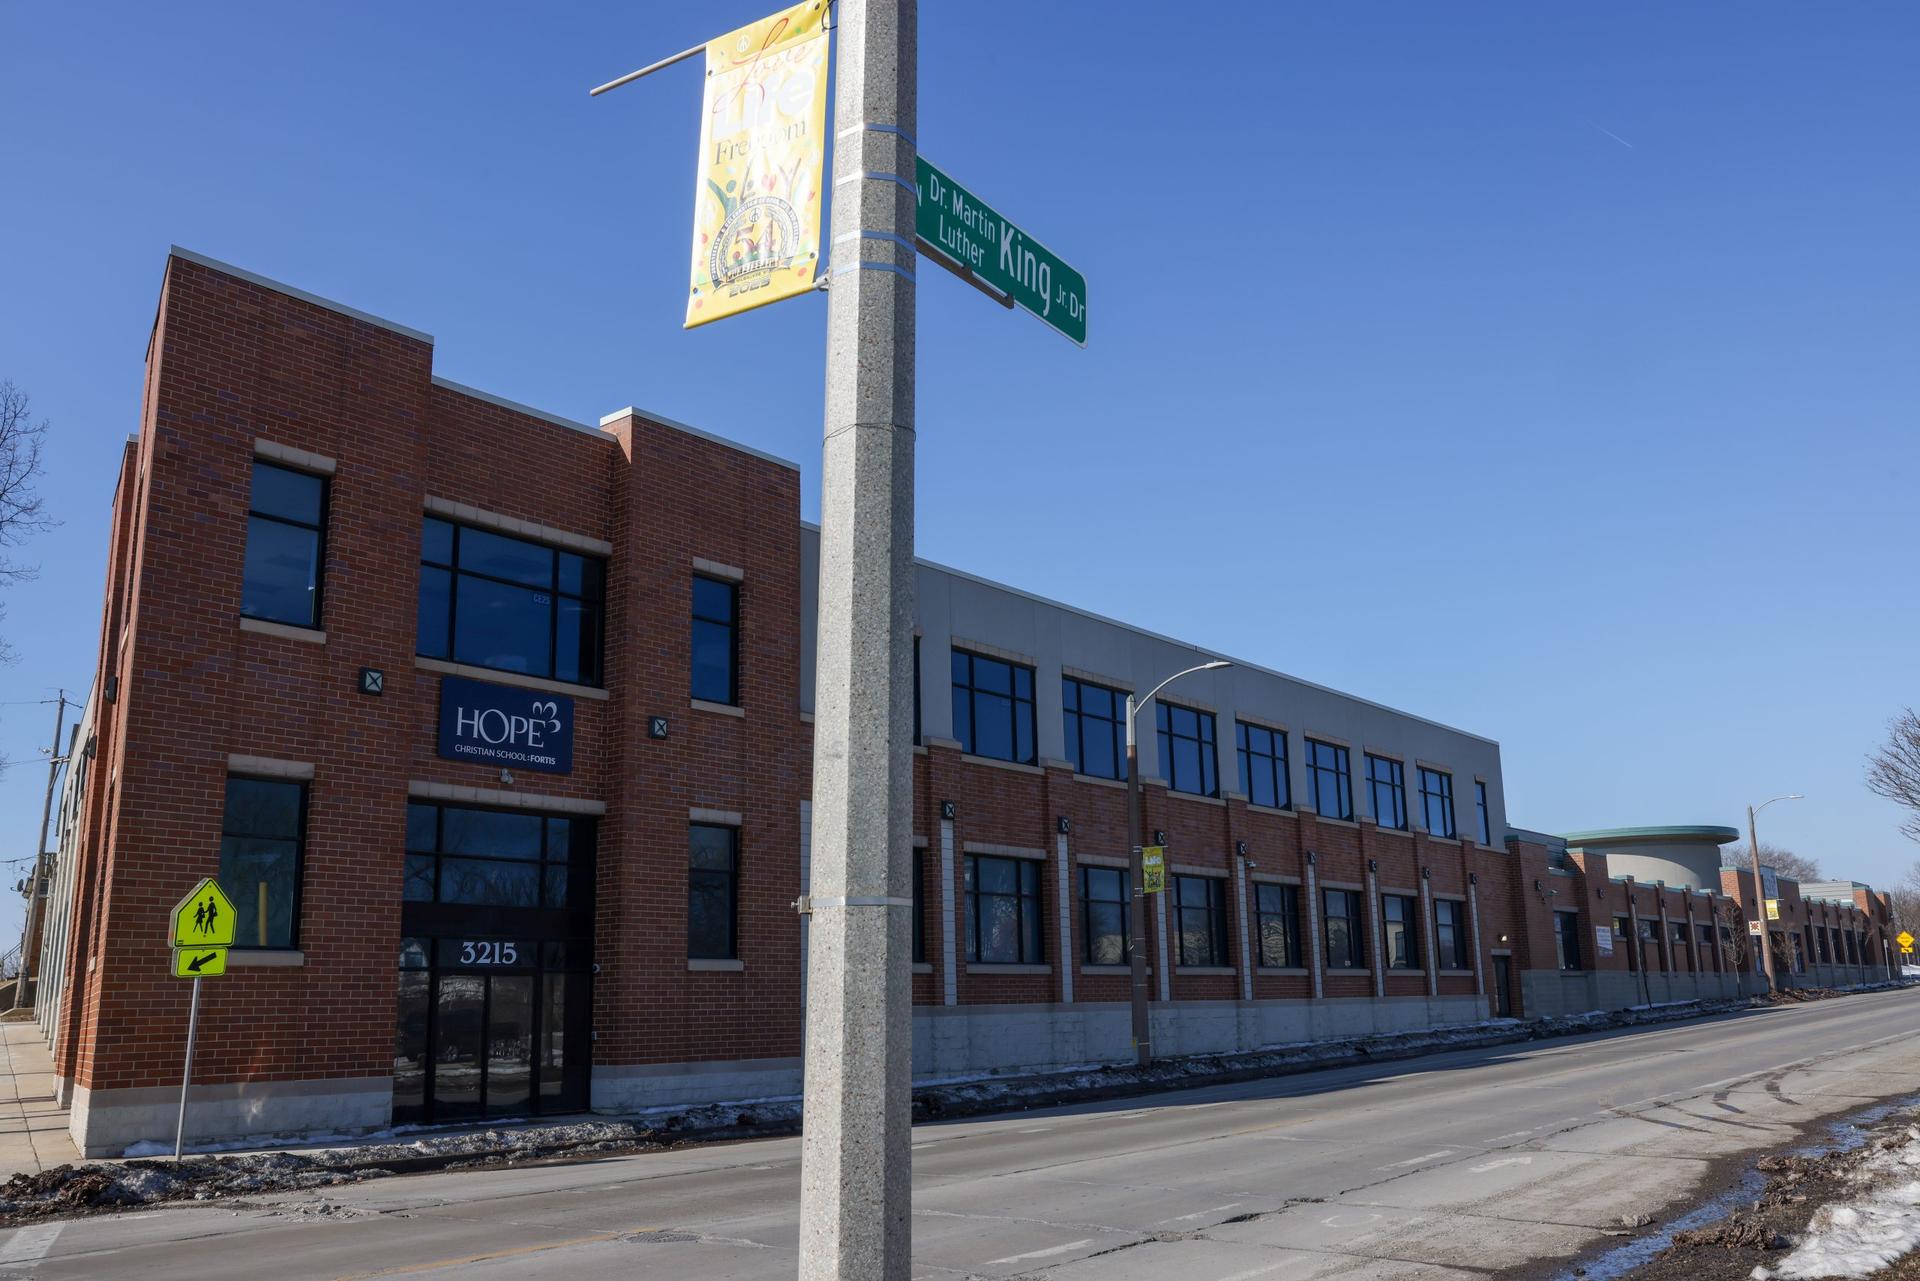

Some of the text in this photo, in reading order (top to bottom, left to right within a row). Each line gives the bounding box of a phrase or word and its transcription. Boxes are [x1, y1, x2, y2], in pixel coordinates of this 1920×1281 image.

[713, 119, 806, 165] Freom
[930, 173, 948, 209] Dr.
[953, 190, 996, 243] Martin
[1000, 220, 1051, 317] King
[1070, 291, 1085, 322] Dr
[939, 215, 985, 267] Luther
[456, 706, 546, 749] HOPE
[454, 743, 496, 757] CHRISTIAN
[460, 941, 517, 965] 3215
